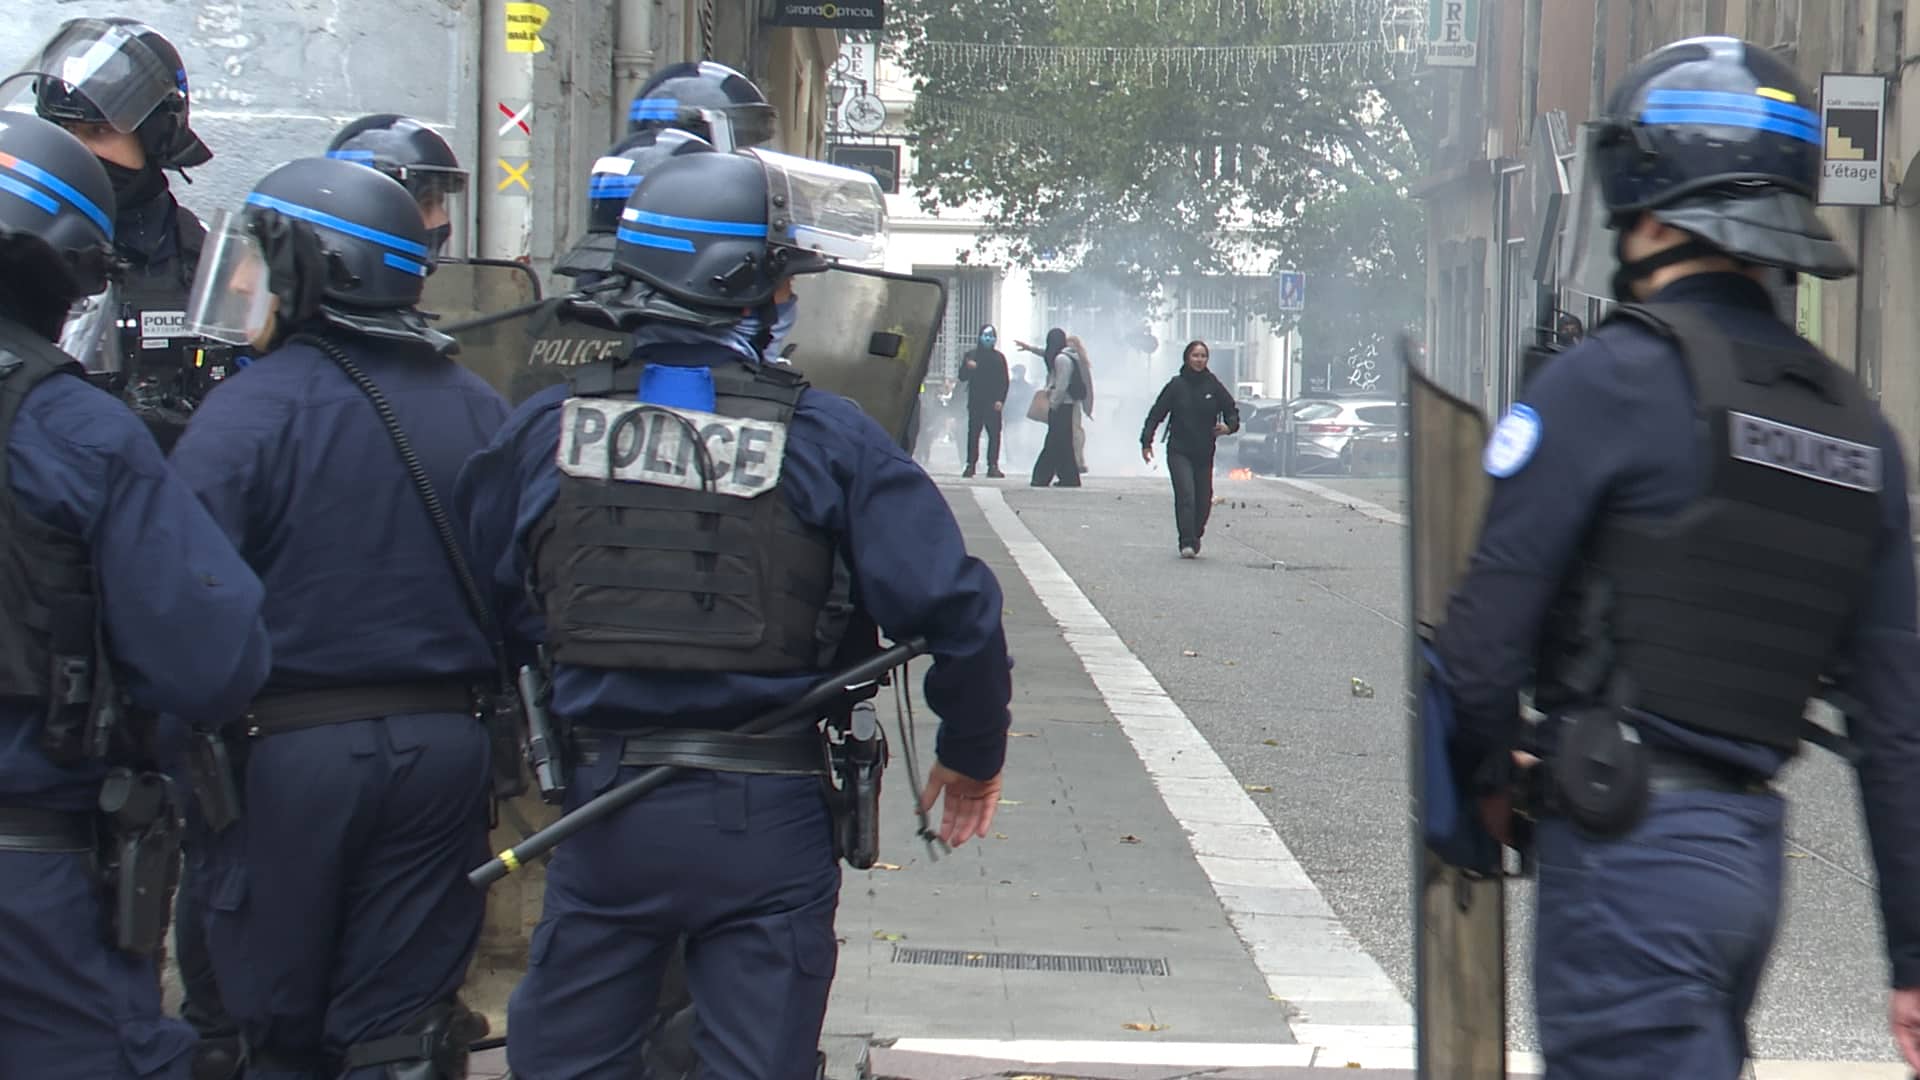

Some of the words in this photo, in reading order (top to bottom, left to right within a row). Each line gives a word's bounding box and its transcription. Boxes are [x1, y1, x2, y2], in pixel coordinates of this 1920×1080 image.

[1823, 163, 1878, 182] L'étage
[568, 406, 773, 488] POLICE
[1743, 421, 1868, 486] POLICE
